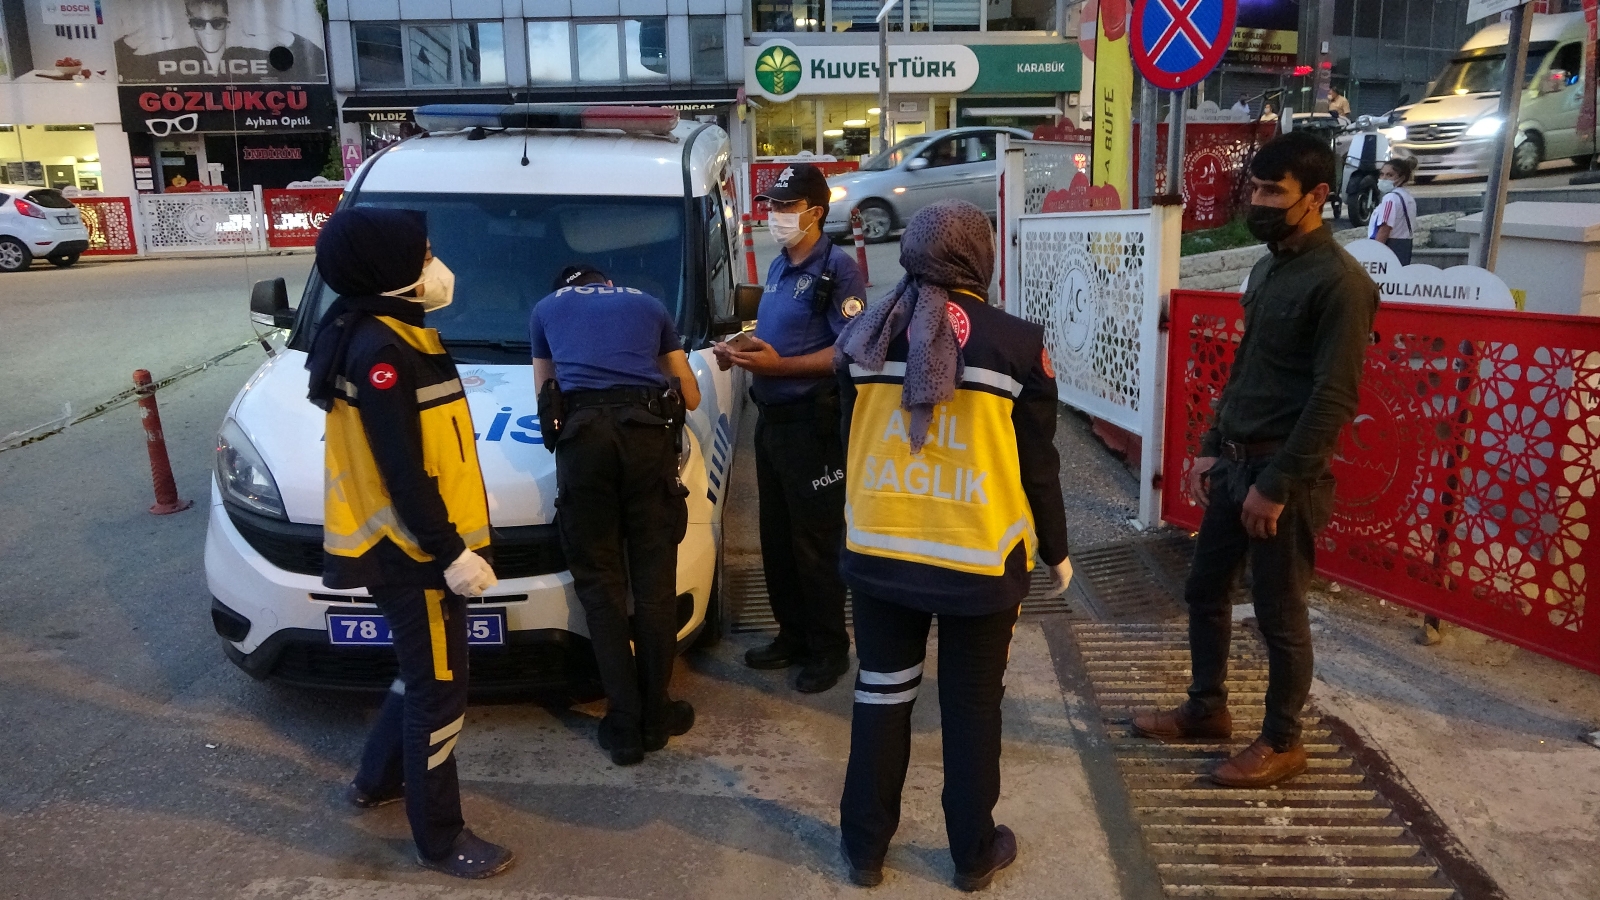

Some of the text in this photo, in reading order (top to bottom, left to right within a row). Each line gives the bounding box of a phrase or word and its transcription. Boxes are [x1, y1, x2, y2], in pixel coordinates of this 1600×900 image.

[158, 59, 268, 75] POLICE
[1017, 61, 1065, 73] KARABÜK
[139, 86, 308, 116] GÖZLÜKÇÜ
[245, 115, 311, 128] Ayhan Optik
[368, 112, 407, 121] YILDIZ
[1101, 87, 1114, 151] BÜFE
[243, 145, 302, 160] İNDİRİM
[1361, 261, 1388, 275] FEN
[1377, 282, 1470, 300] KULLANALIM
[863, 453, 988, 505] SAĞLIK
[340, 620, 378, 639] 78
